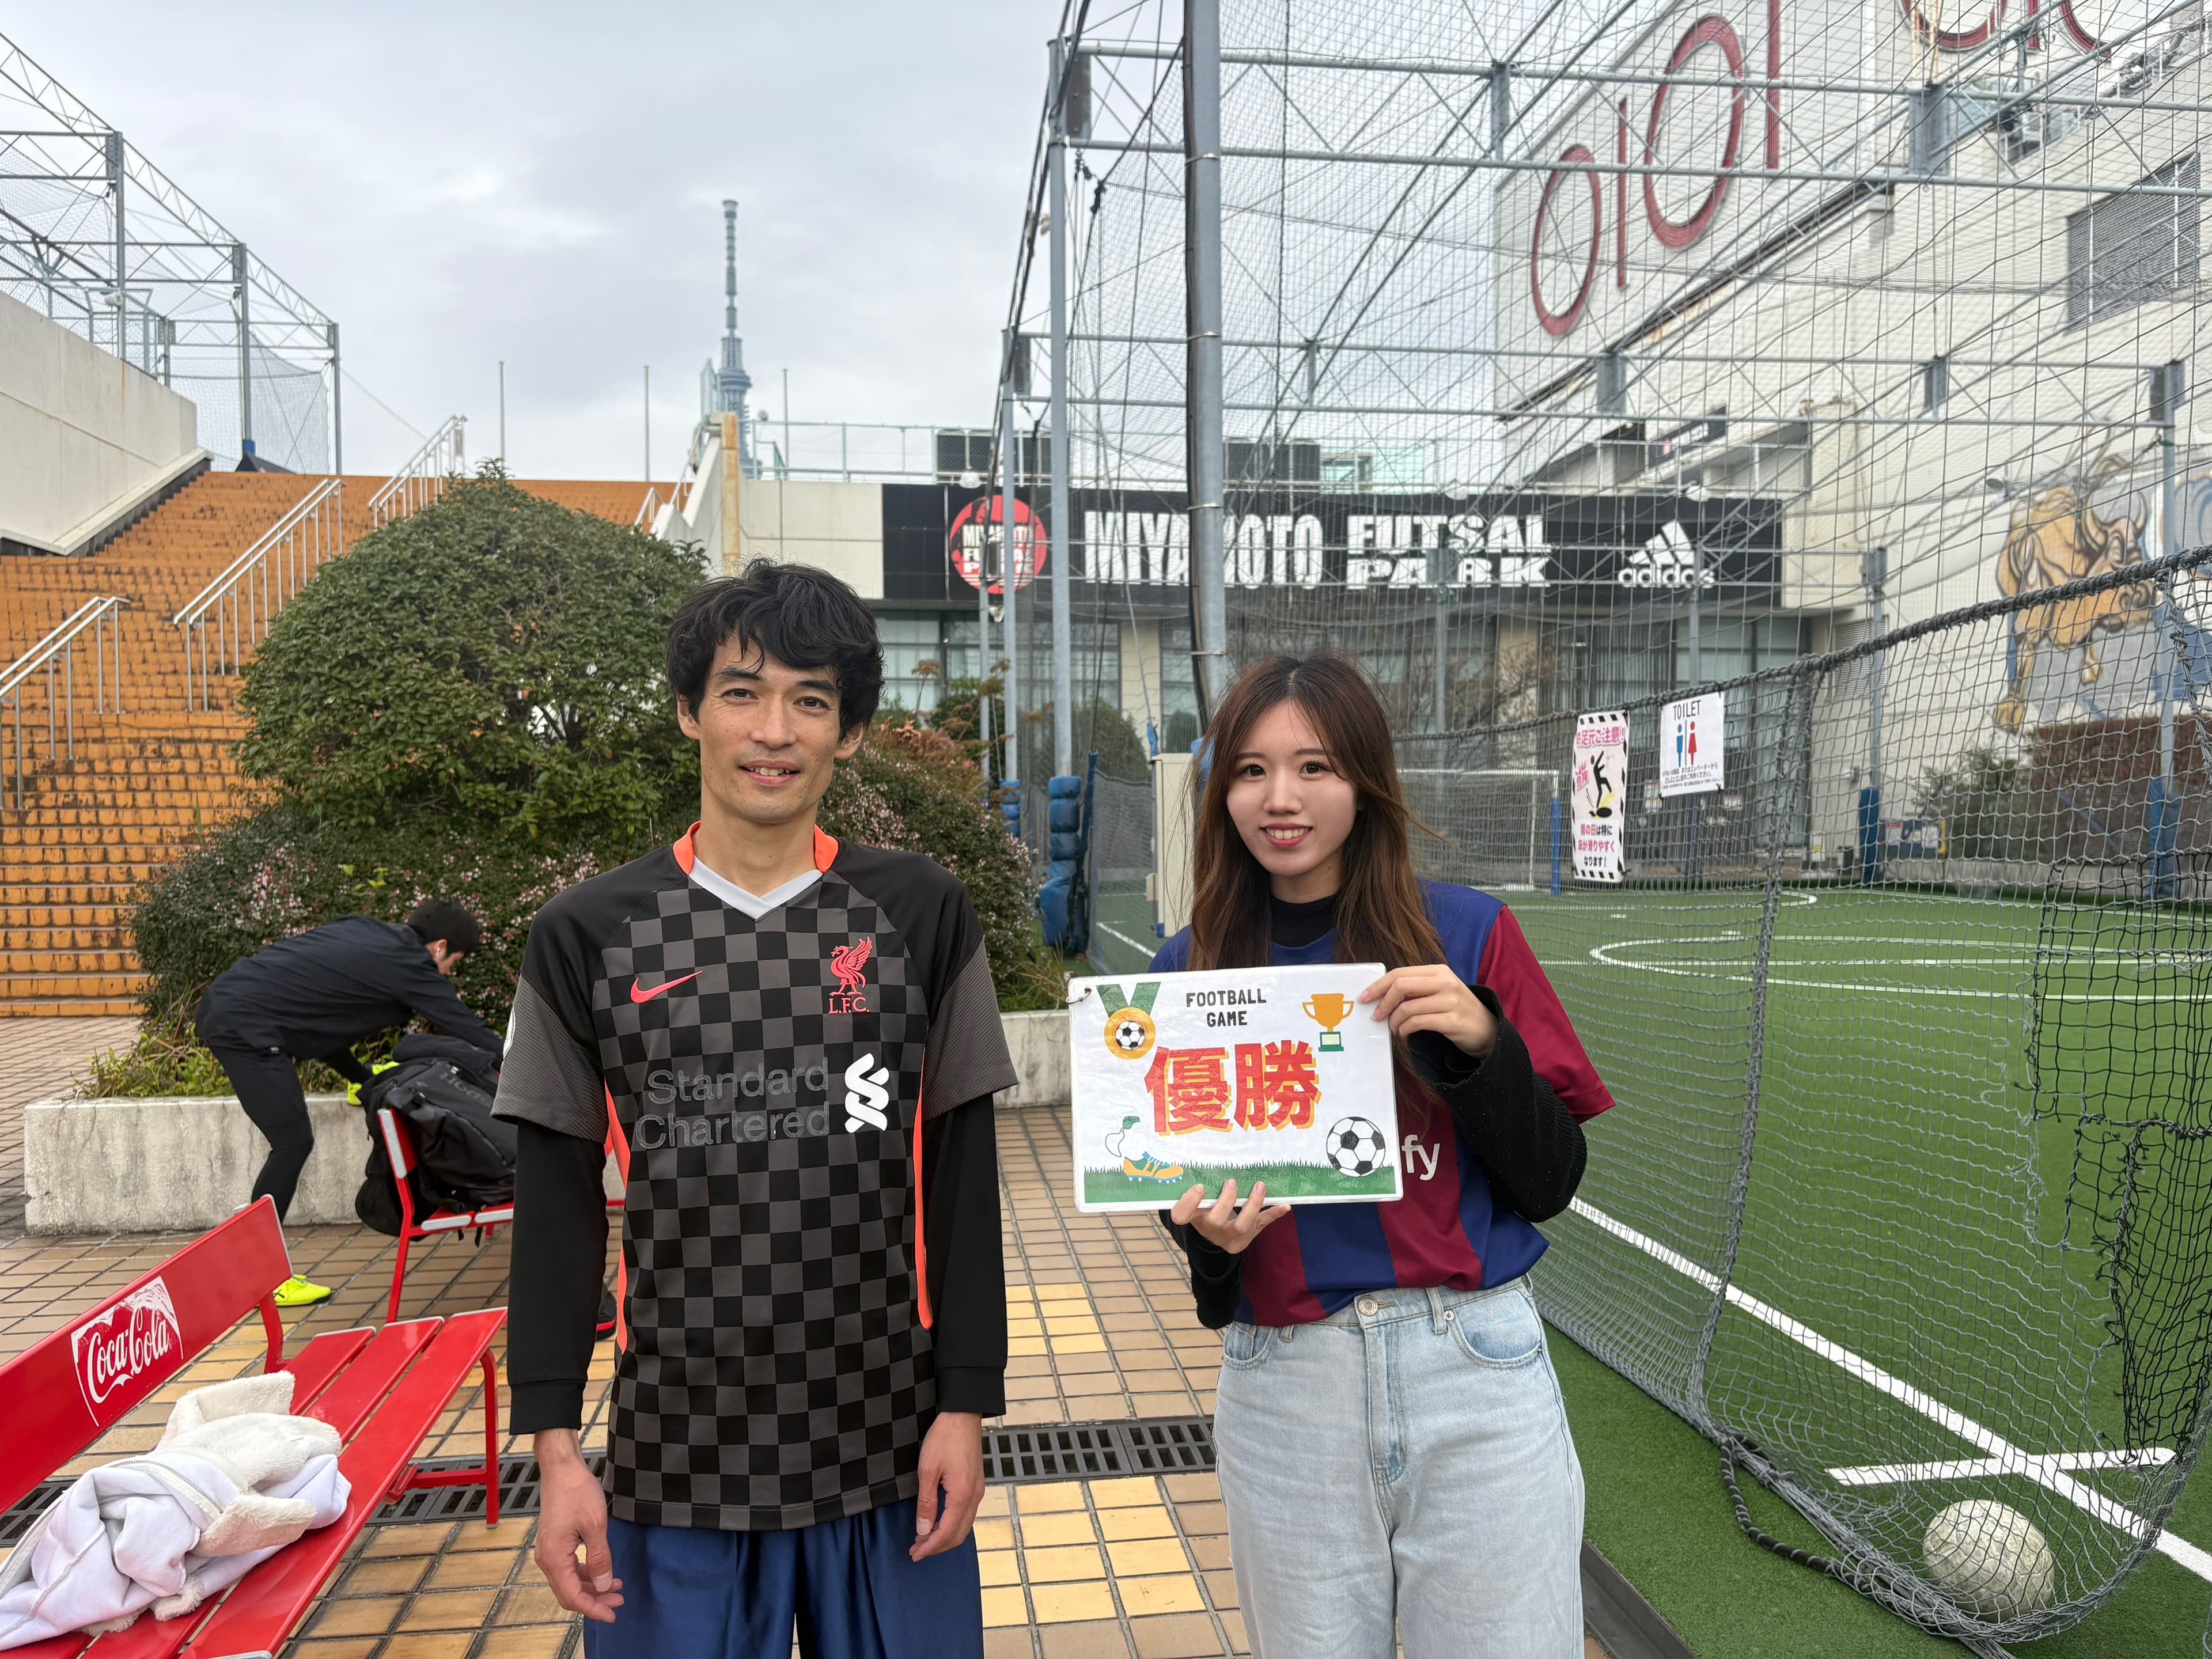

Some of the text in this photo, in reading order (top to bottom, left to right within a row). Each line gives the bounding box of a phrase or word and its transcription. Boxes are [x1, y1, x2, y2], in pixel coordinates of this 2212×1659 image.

[1347, 514, 1552, 555] FUTSAL
[1618, 561, 1715, 589] adidas
[1673, 699, 1701, 721] TOILET
[1581, 823, 1612, 836] 雨の日は特に
[828, 997, 870, 1014] L.F.C.
[1186, 988, 1267, 1007] FOOTBALL
[1207, 1010, 1248, 1027] GAME
[647, 1056, 828, 1105] Standard
[1144, 1039, 1322, 1136] 優勝
[634, 1101, 830, 1150] Chartered
[88, 1304, 170, 1403] Coca-Cola
